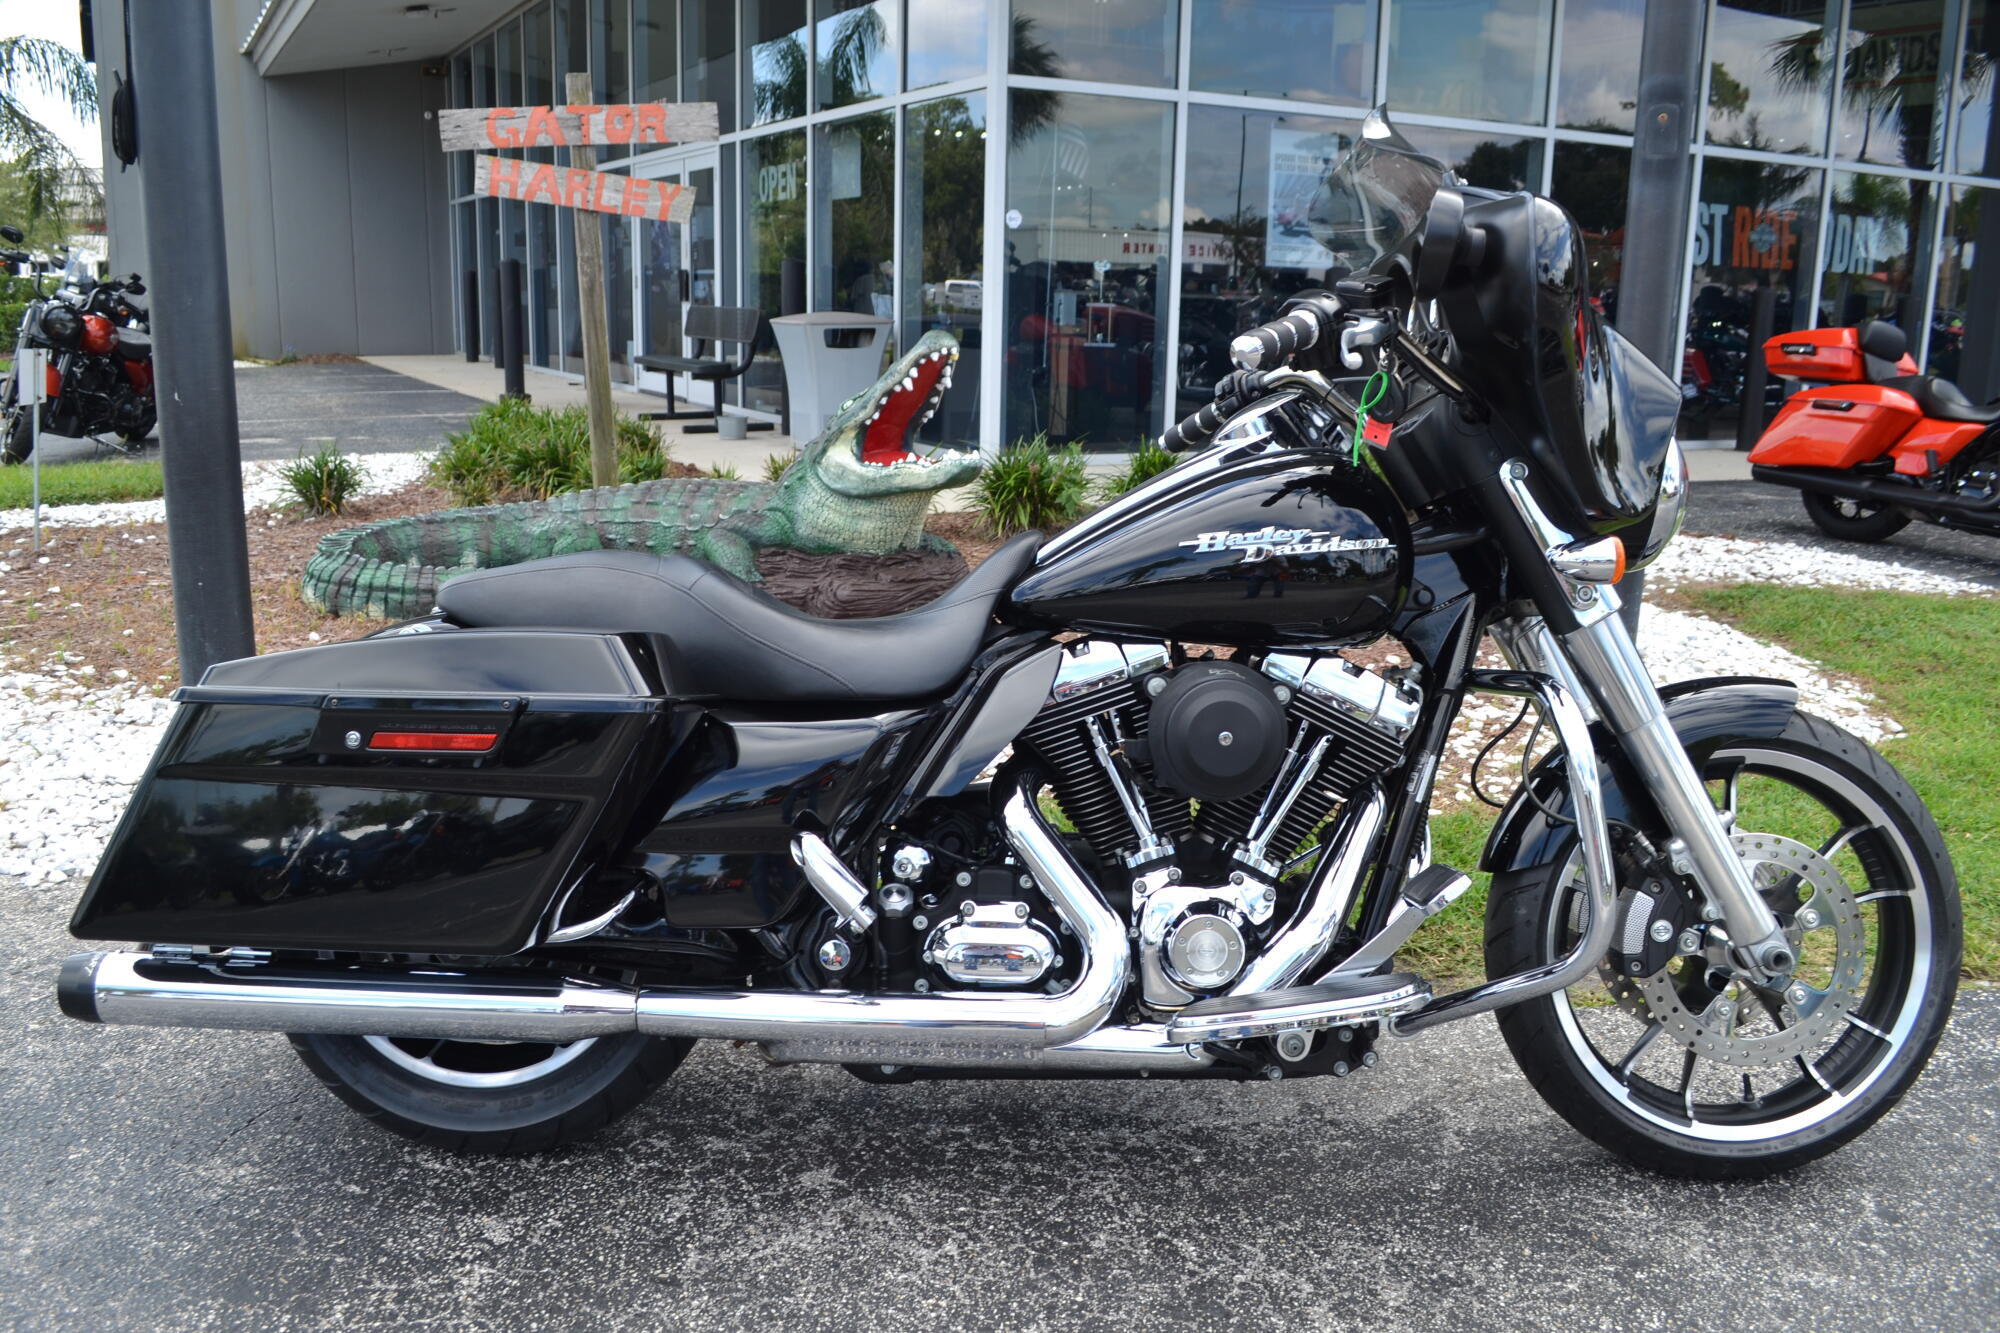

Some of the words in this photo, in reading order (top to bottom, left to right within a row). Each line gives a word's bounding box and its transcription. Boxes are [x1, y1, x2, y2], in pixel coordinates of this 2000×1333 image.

[486, 104, 669, 148] GATOR
[488, 157, 681, 221] HARLEY
[759, 162, 797, 203] OPEN
[1693, 201, 1728, 267] ST
[1193, 526, 1330, 554] Harley
[1240, 537, 1396, 563] Davidson
